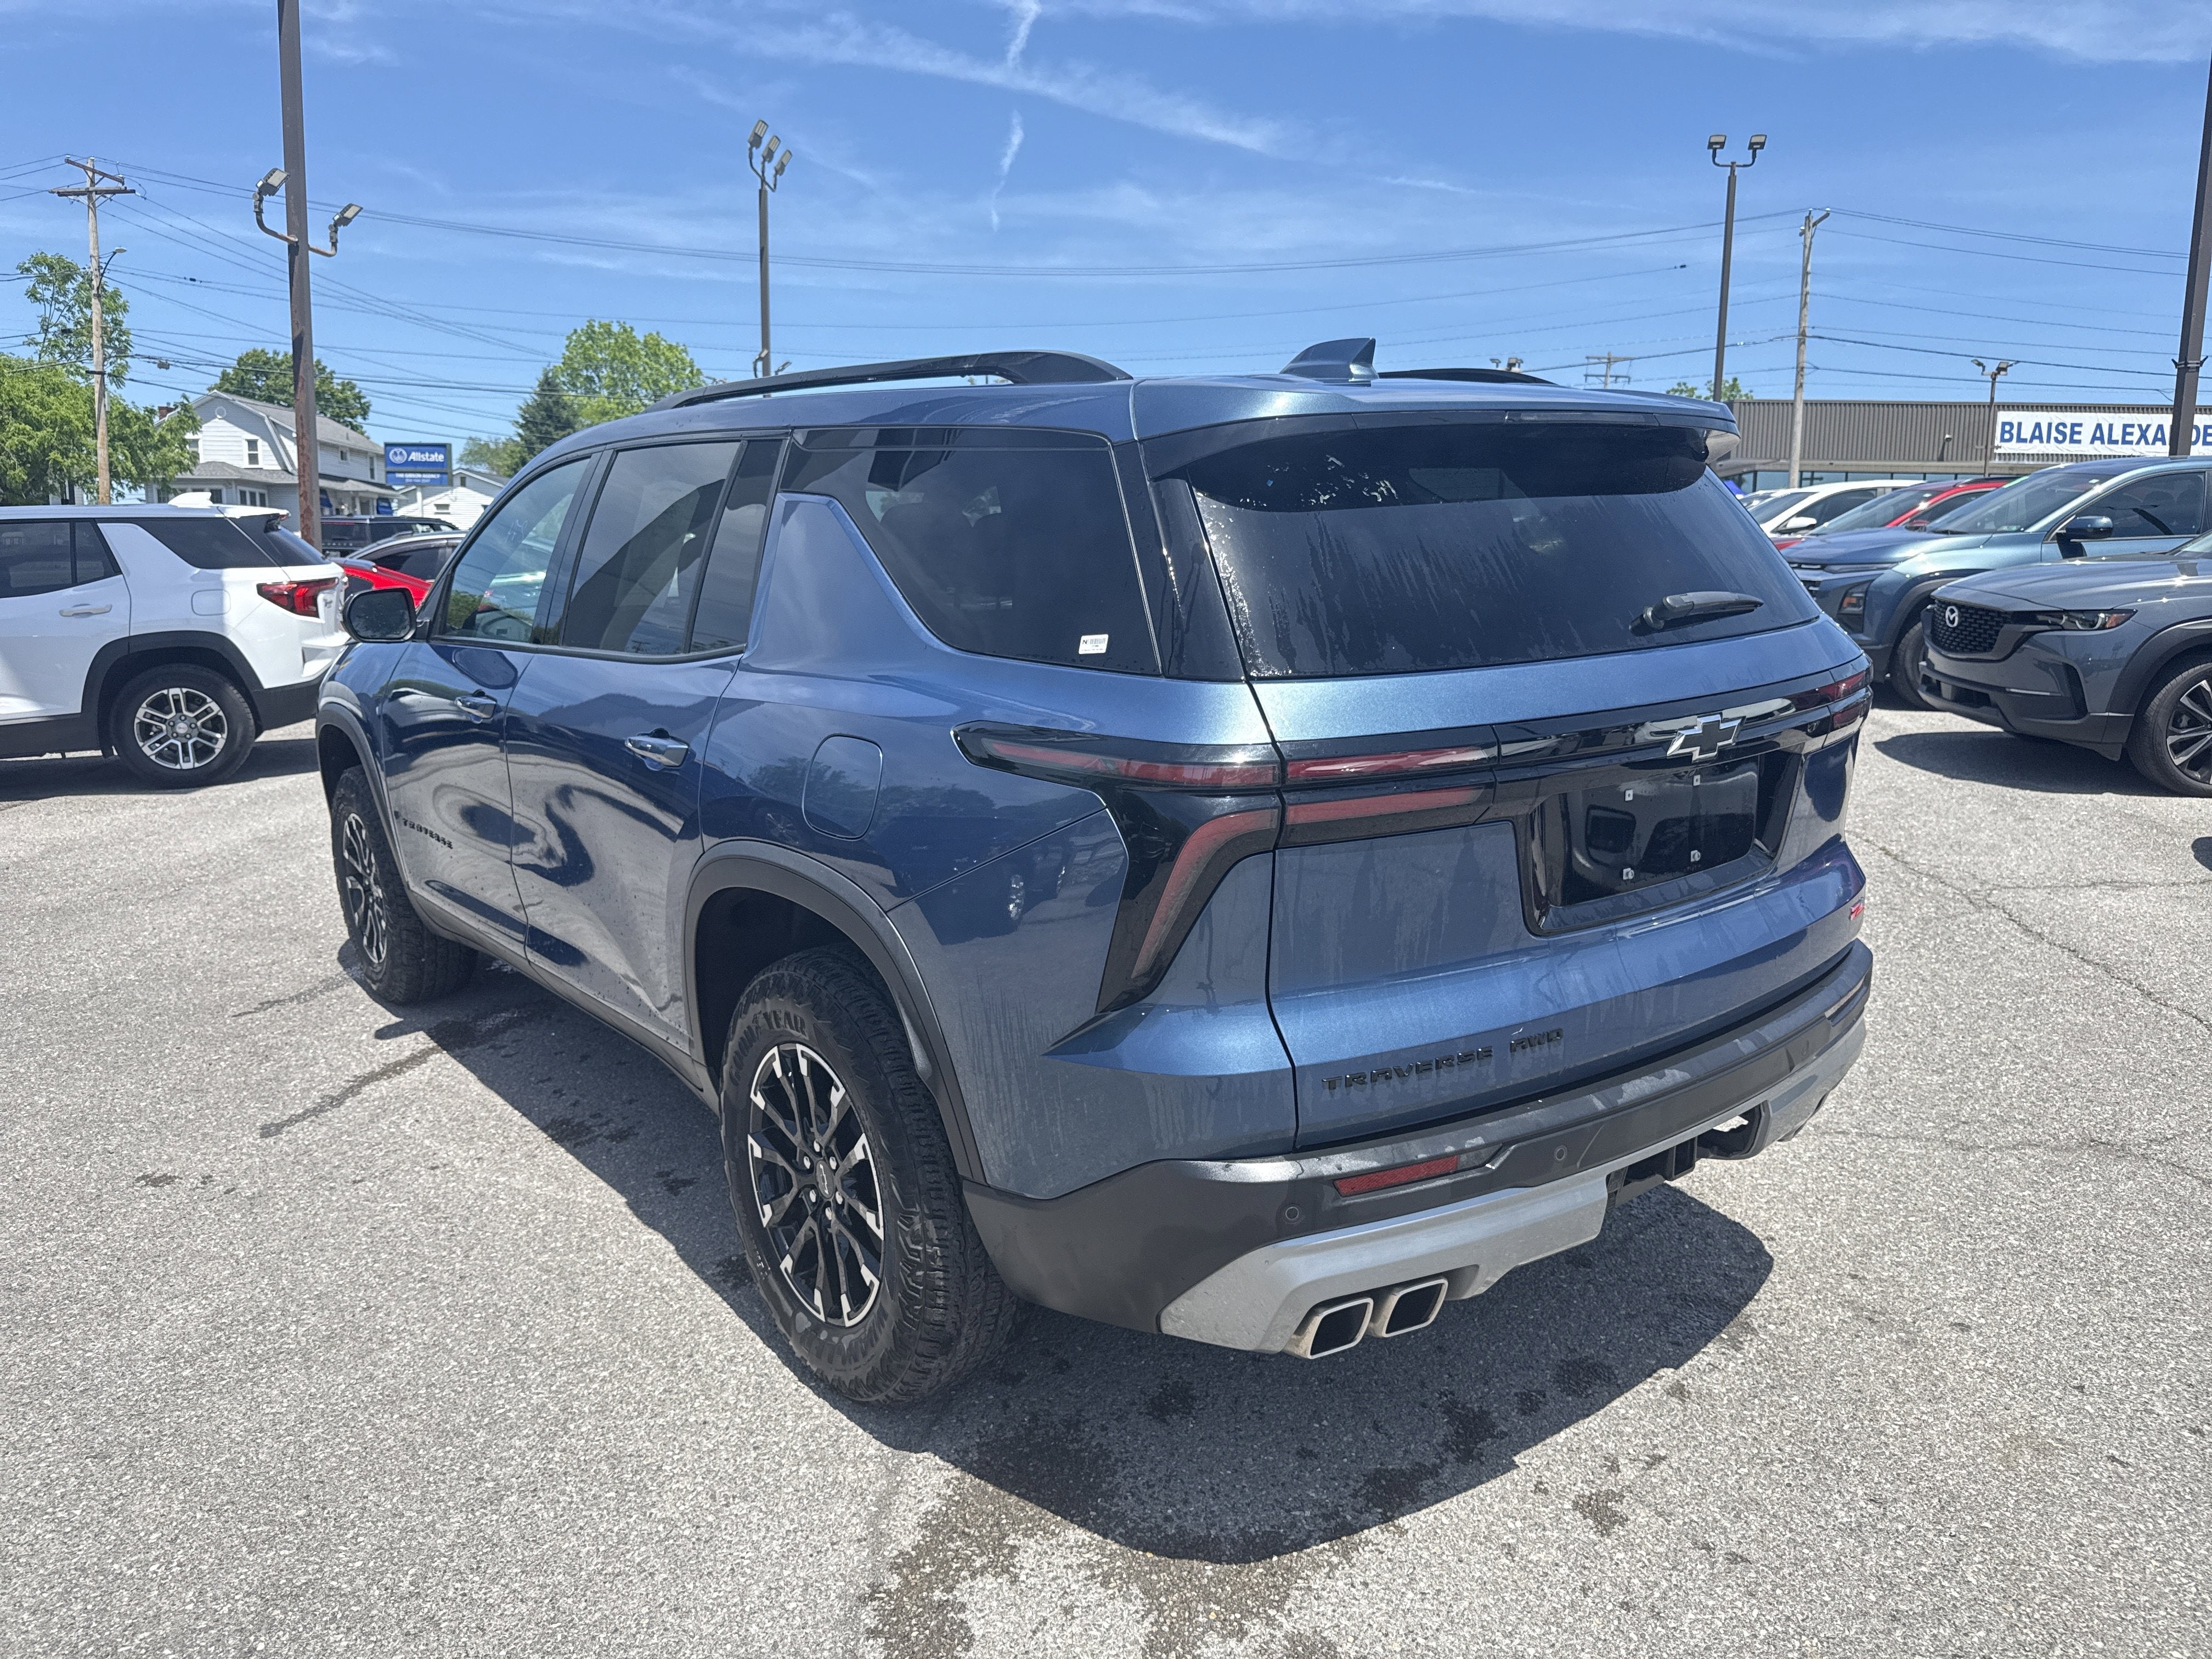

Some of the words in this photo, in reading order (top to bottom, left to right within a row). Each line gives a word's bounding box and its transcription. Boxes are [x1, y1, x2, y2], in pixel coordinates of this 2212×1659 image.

[2000, 421, 2083, 444] BLAISE
[2090, 423, 2212, 446] ALEXADE
[408, 452, 444, 462] Allstate
[1322, 1046, 1493, 1090] TRAVERSE
[1510, 1028, 1563, 1052] AWD
